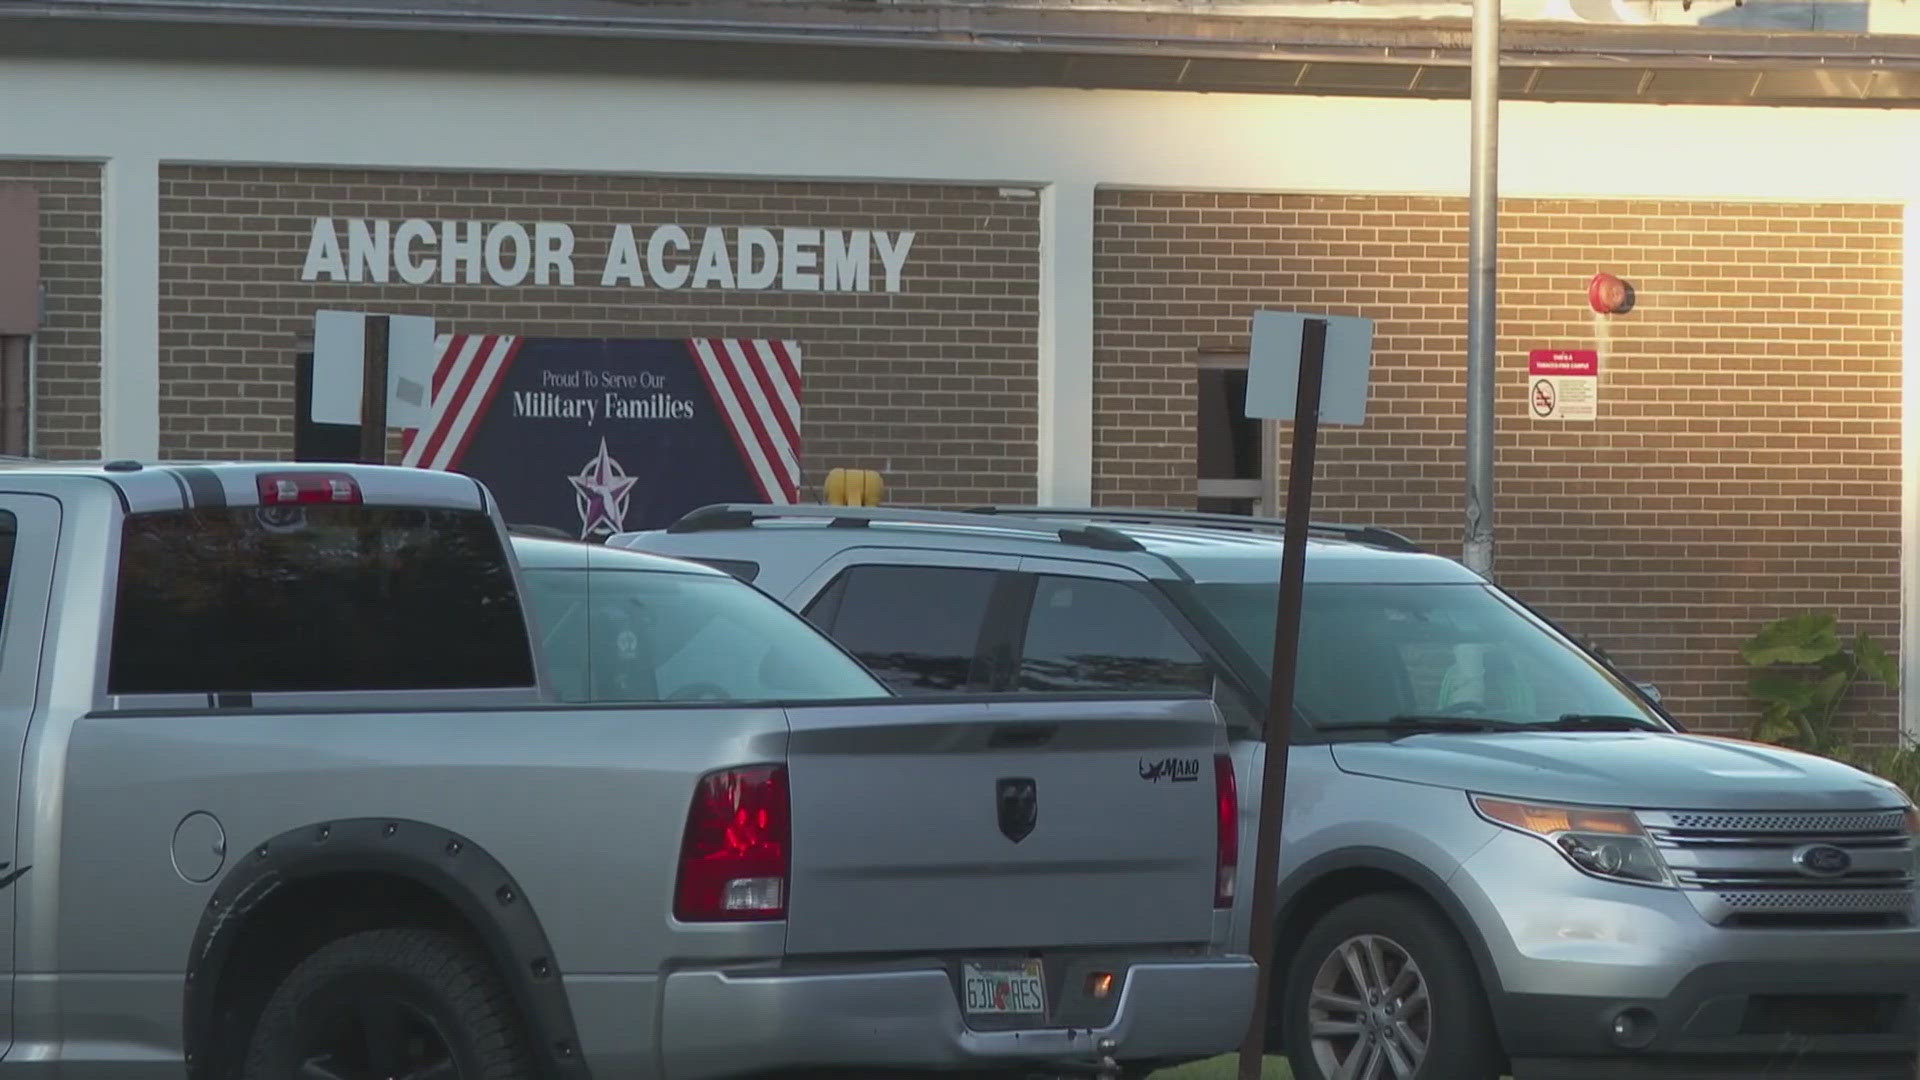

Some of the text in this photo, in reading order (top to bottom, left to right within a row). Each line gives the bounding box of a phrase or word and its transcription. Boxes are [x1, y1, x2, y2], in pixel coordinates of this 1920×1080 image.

[300, 218, 916, 293] ANCHOR ACADEMY
[542, 370, 666, 389] Proud To Serve Our
[512, 391, 695, 427] Military Families
